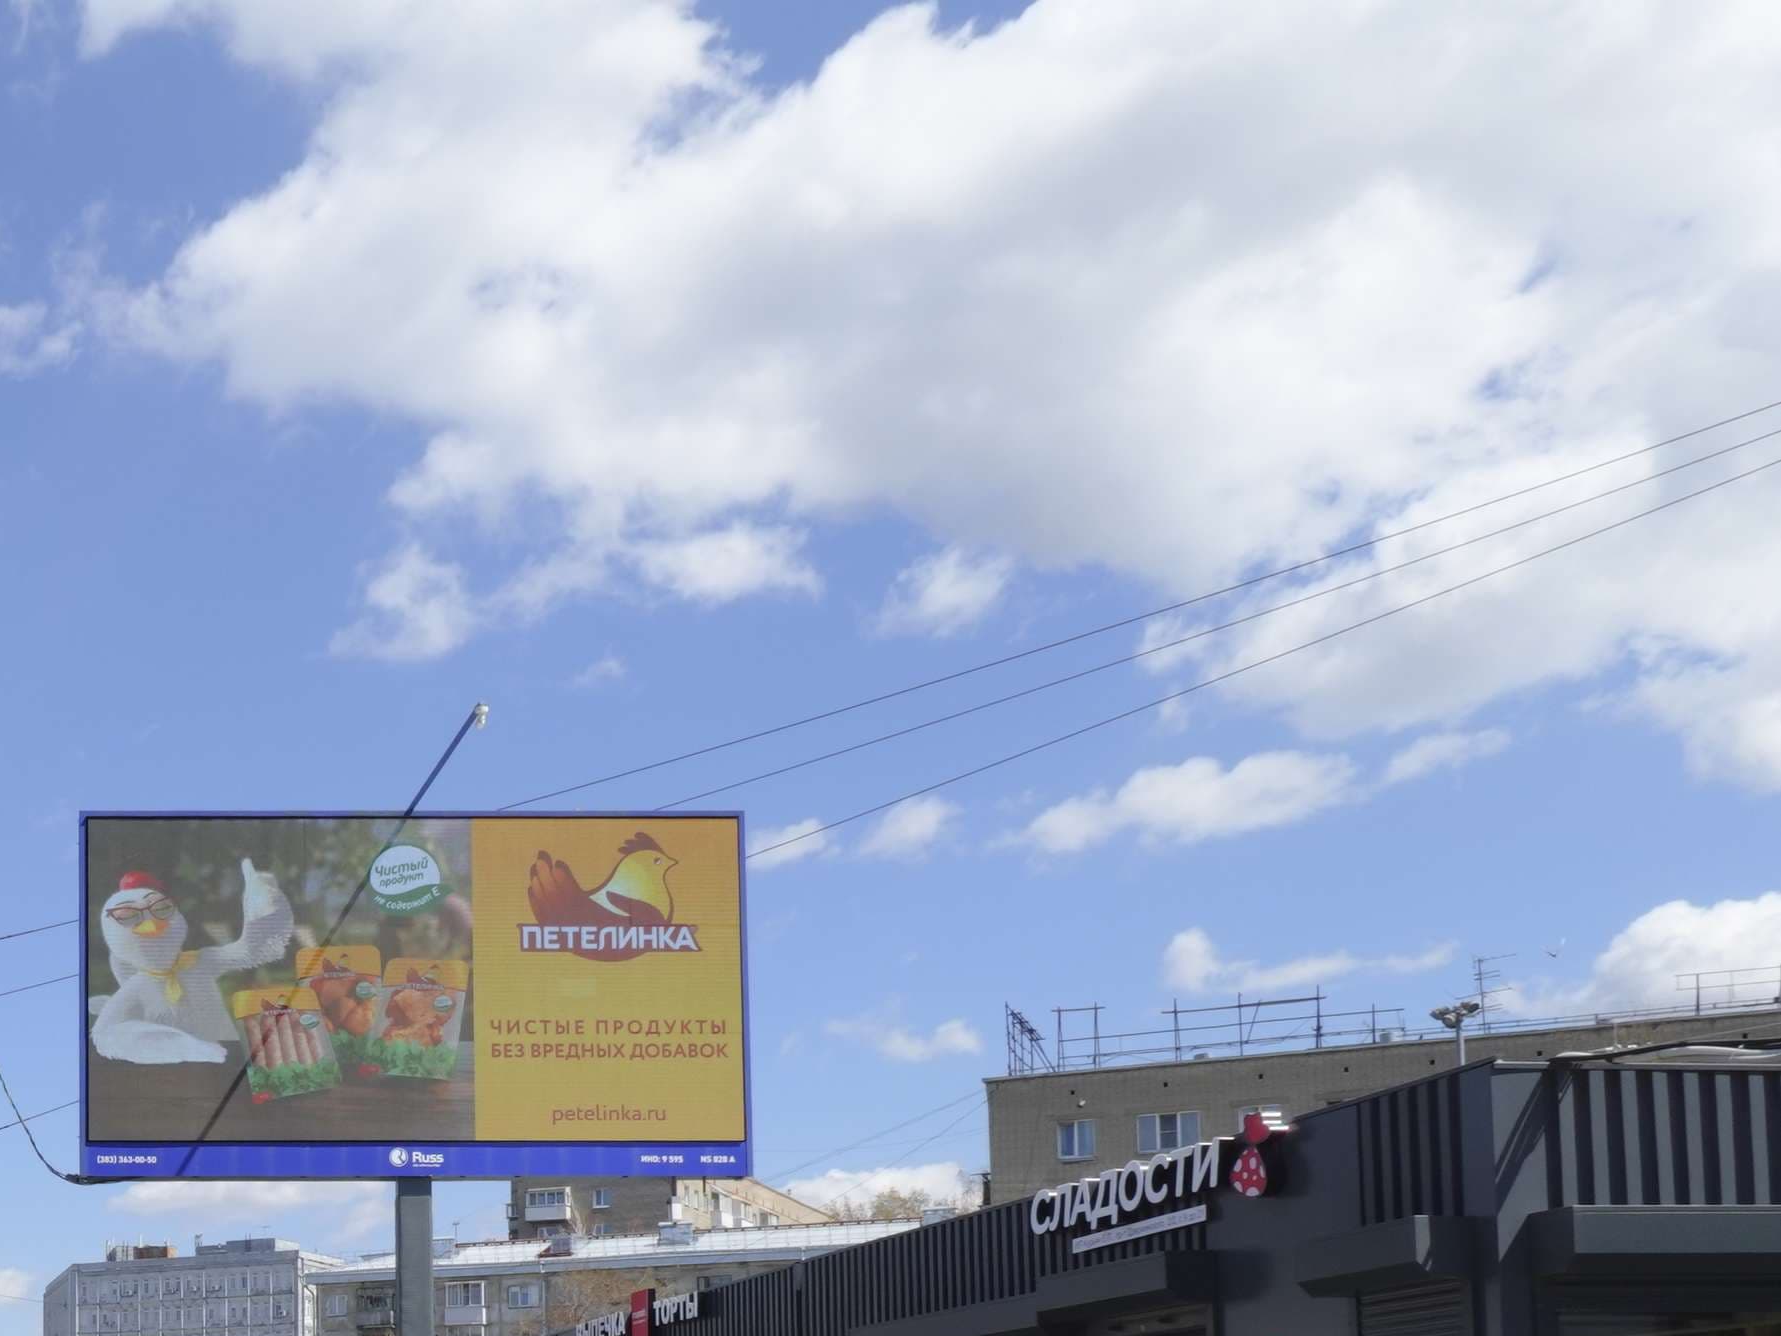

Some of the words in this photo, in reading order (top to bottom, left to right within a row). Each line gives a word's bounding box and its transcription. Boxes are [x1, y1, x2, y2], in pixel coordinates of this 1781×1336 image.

[375, 856, 428, 877] Чистый
[380, 873, 424, 888] продукт
[522, 925, 699, 951] ПЕТЕЛИНКА
[490, 1019, 585, 1035] ЧИСТЫЕ
[595, 1019, 727, 1036] ПРОДУКТЫ
[491, 1043, 525, 1058] БЕЗ
[530, 1043, 626, 1060] ВРЕДНЫХ
[629, 1043, 728, 1060] ДОБАВОК
[552, 1104, 667, 1125] petelinka.ru
[412, 1151, 444, 1163] Russ
[1030, 1136, 1220, 1235] СЛАДОСТИ
[653, 1291, 698, 1326] ТОРТЫ
